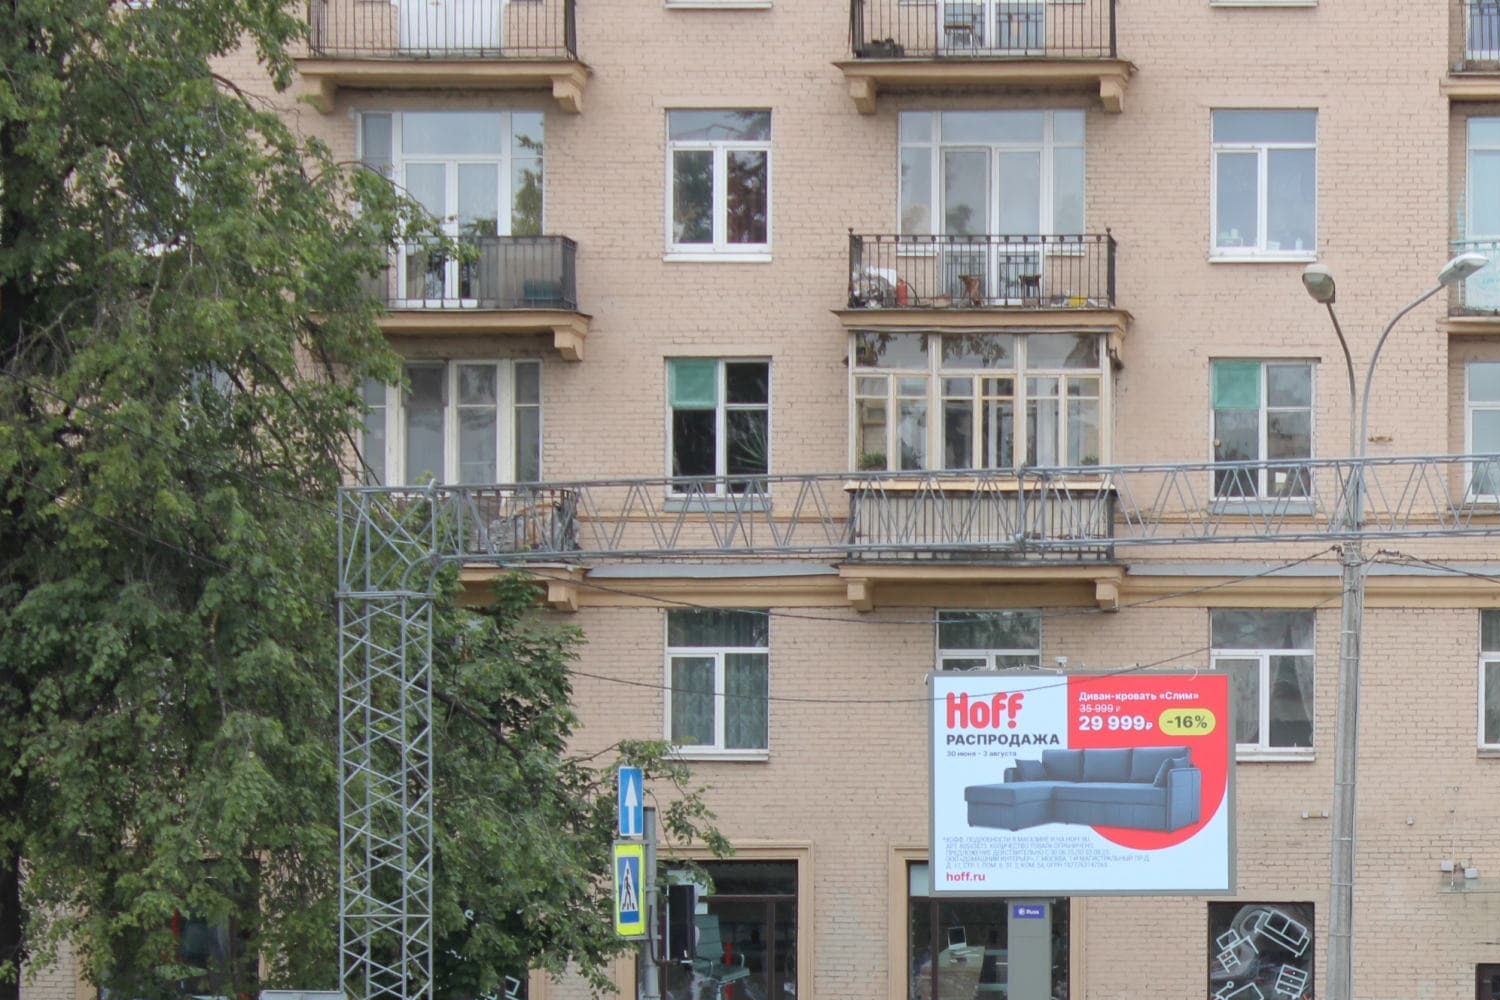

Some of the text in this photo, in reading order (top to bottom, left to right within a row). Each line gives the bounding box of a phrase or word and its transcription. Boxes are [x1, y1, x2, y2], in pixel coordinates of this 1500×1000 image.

[1079, 691, 1200, 702] Диван-кровать «Слим»
[1078, 715, 1104, 731] 29
[1166, 715, 1208, 729] -16%
[946, 734, 1061, 748] РАСПРОДАЖА
[989, 751, 1017, 759] августа
[946, 871, 986, 881] hoff.ru
